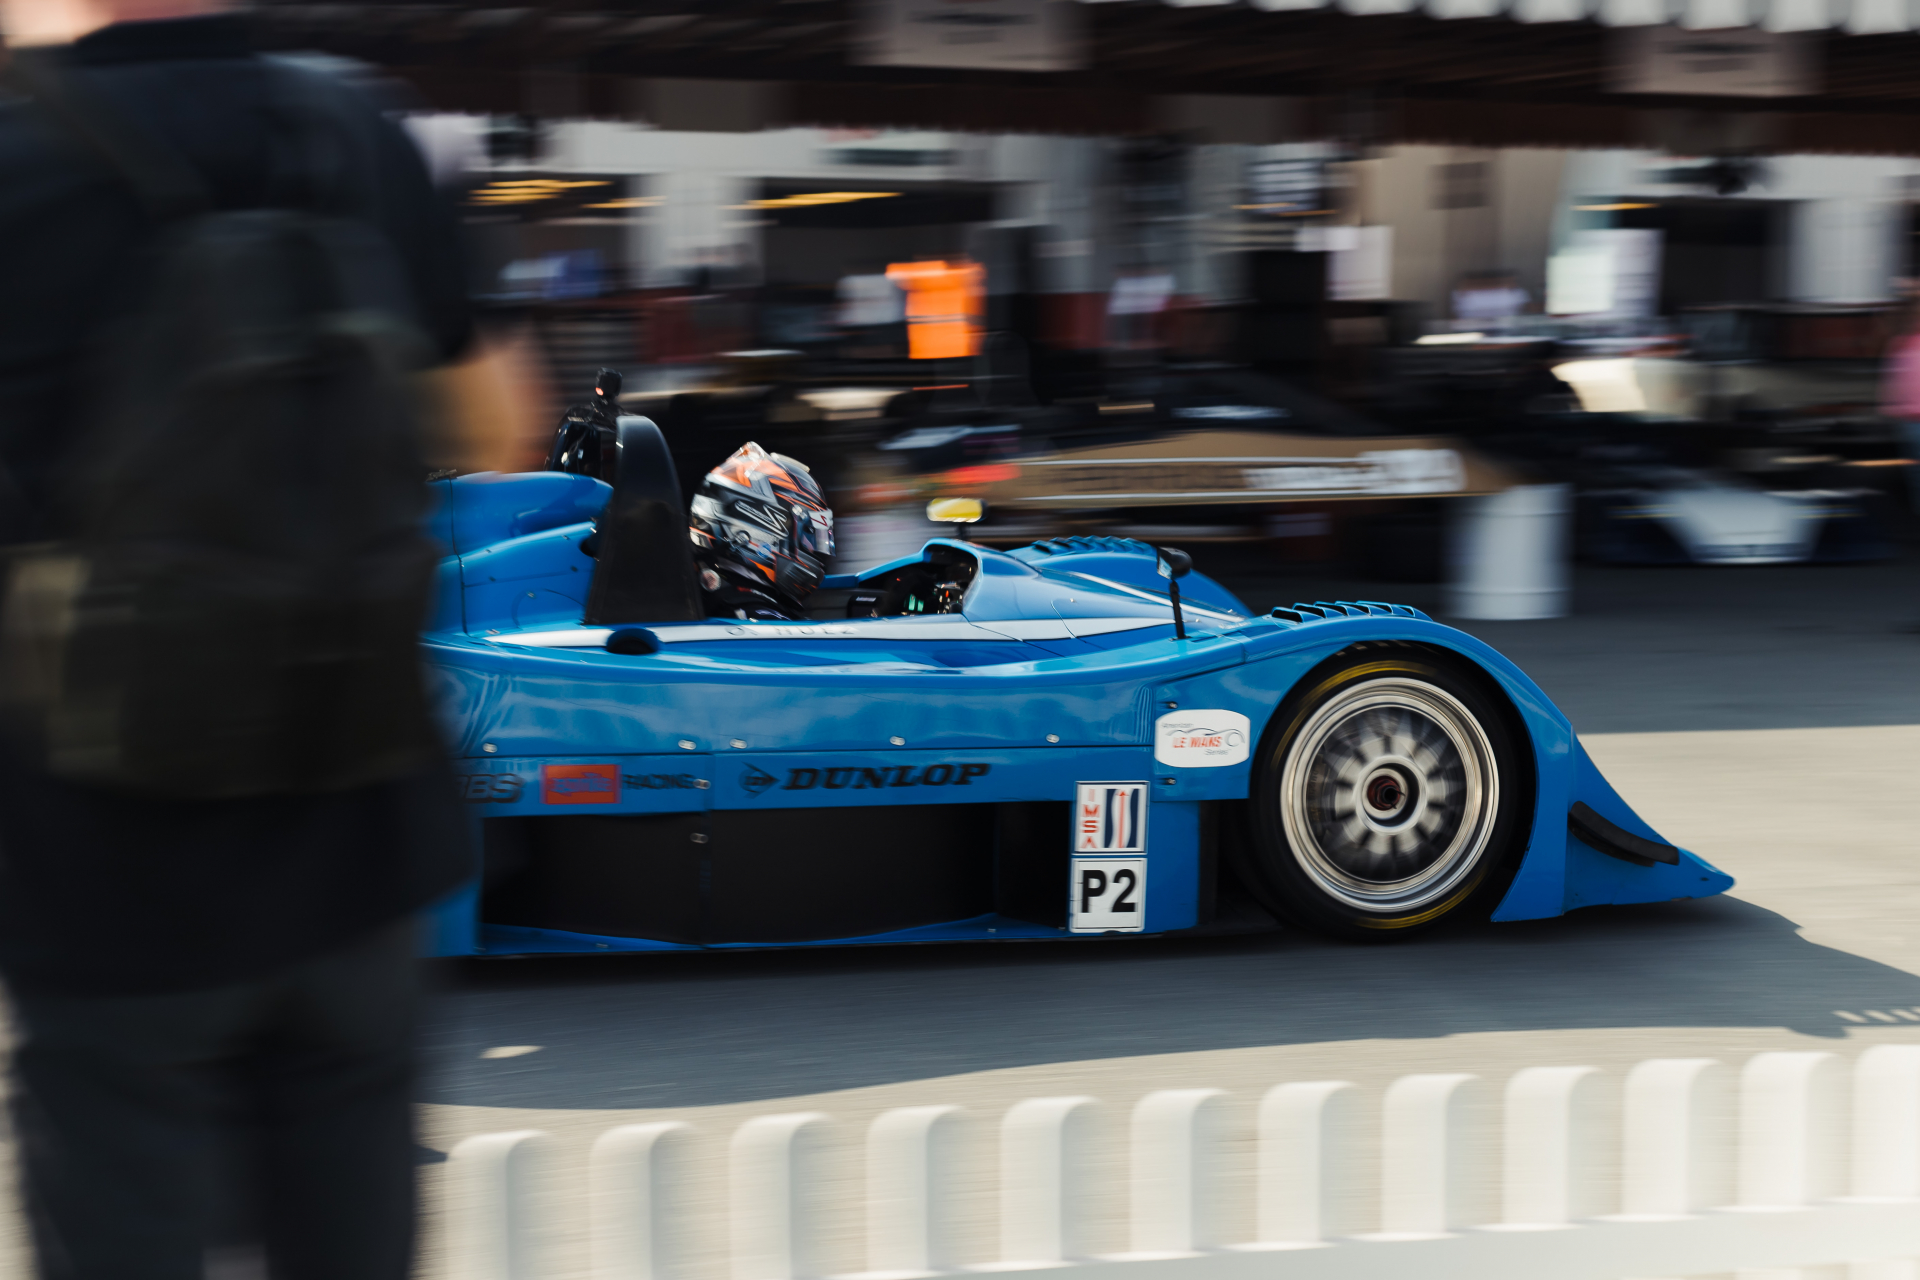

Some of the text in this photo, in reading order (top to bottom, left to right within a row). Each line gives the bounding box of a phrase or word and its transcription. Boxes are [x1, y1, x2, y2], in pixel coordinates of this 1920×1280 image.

[1172, 736, 1223, 748] LE MANS
[622, 773, 695, 790] RACING
[781, 763, 991, 790] DUNLOP
[1080, 788, 1100, 849] IMSA
[1081, 868, 1137, 913] P2
